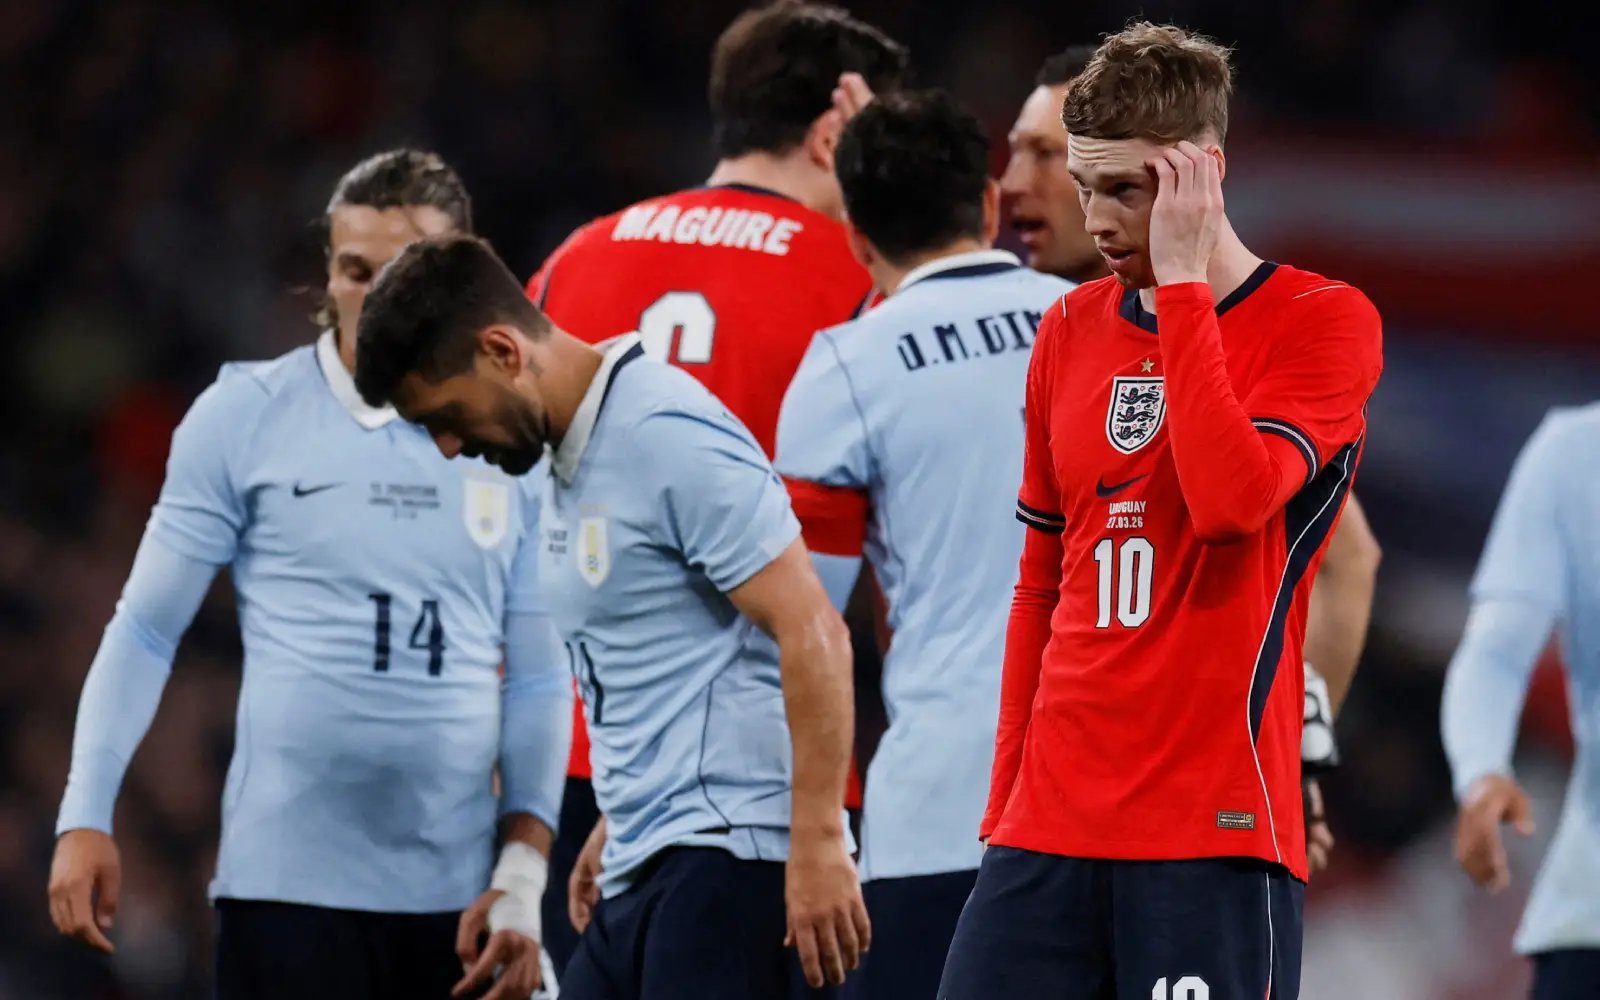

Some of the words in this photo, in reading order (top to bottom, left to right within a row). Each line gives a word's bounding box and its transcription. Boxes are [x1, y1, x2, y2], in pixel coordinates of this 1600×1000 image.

[611, 205, 804, 256] MAGUIRE
[1106, 516, 1144, 529] 27.03.26
[1093, 536, 1154, 629] 10
[368, 592, 447, 677] 14
